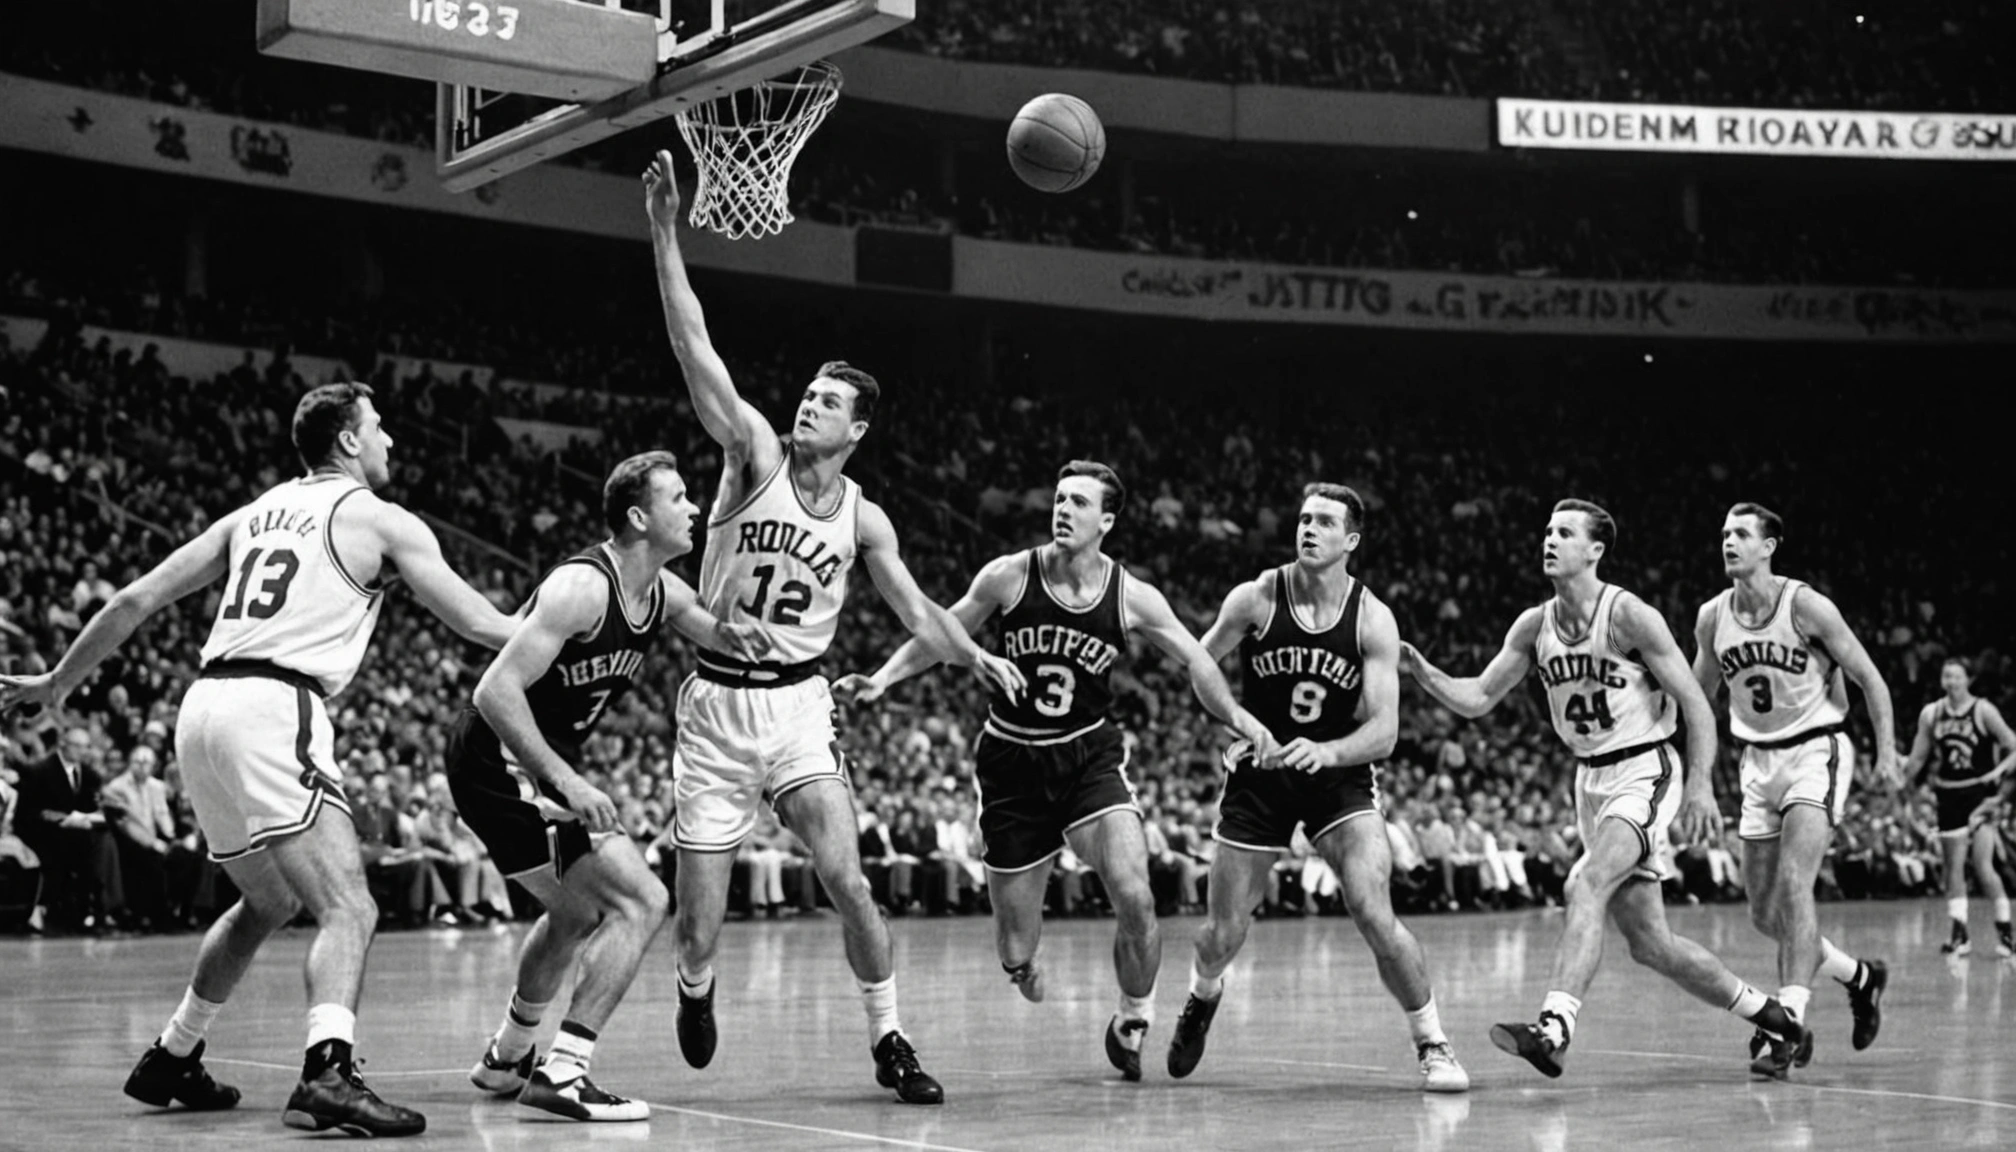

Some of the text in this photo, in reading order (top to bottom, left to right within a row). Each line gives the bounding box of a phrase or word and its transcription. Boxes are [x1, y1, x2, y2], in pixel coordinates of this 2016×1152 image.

[223, 547, 300, 620] 13
[739, 564, 812, 626] 12
[1034, 664, 1076, 717] 3
[1564, 688, 1616, 735] 44
[1744, 674, 1774, 714] 3
